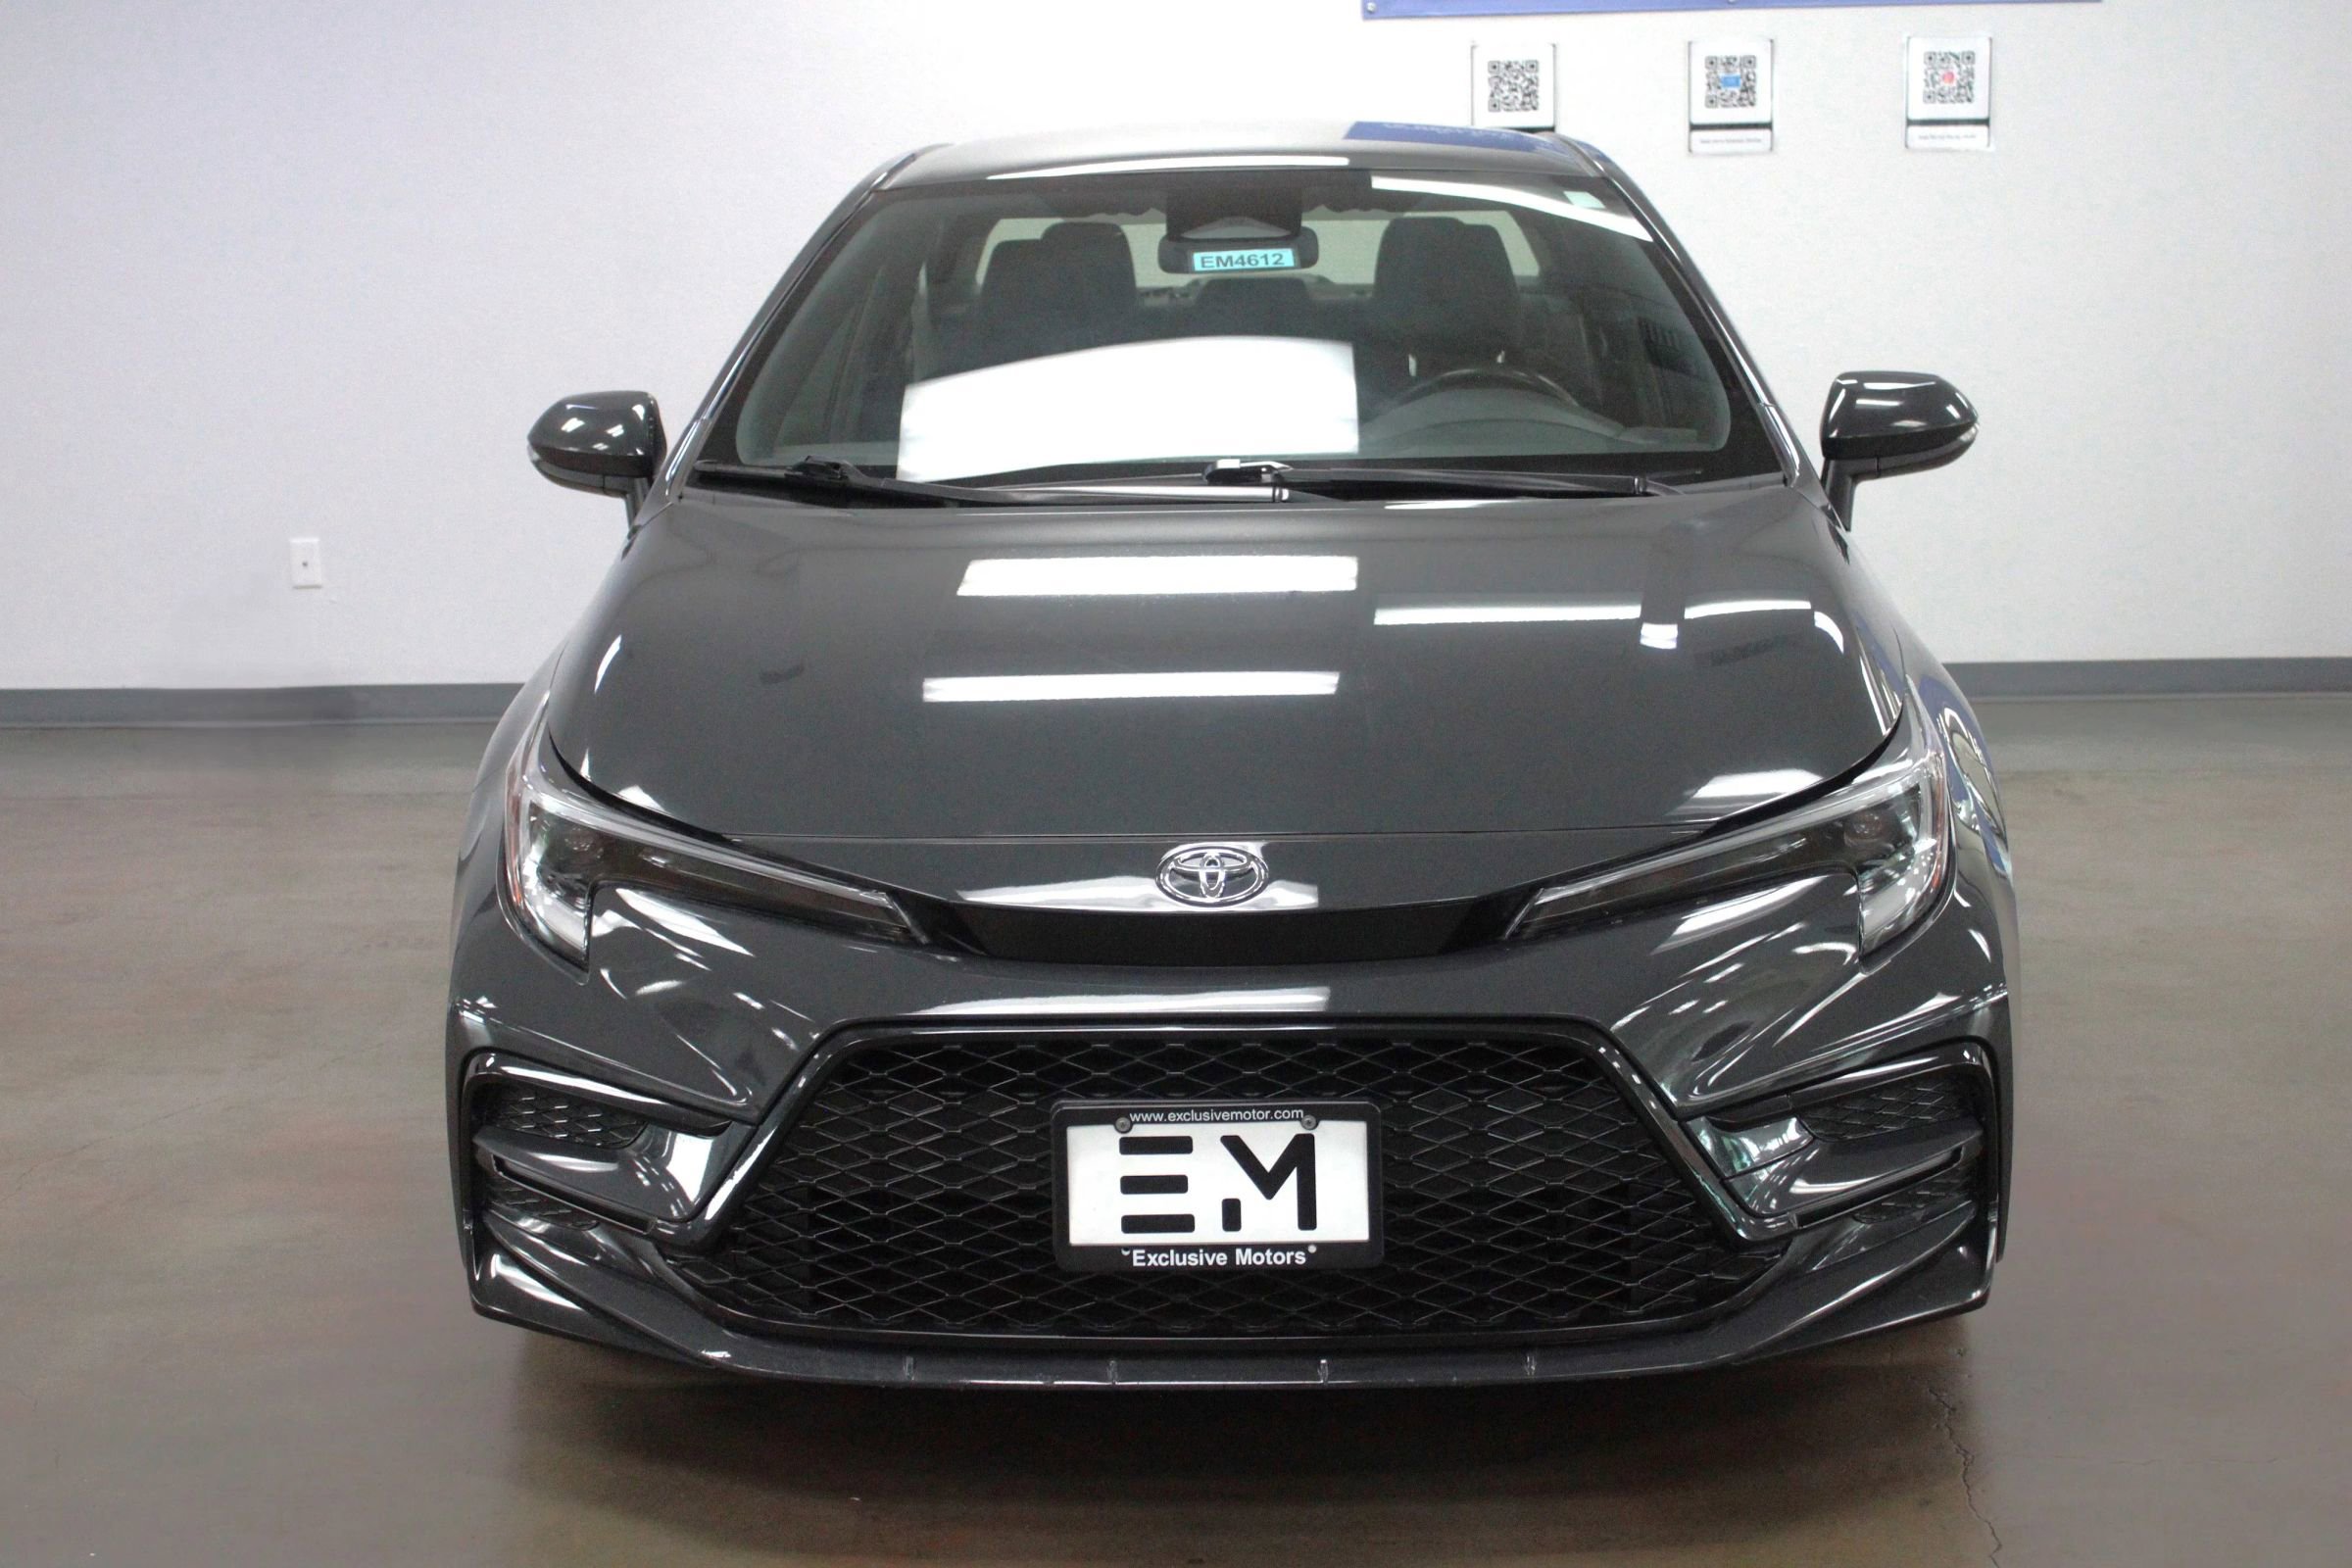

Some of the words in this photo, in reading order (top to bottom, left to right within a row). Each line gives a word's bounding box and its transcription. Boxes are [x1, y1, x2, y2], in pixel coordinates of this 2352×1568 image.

[1200, 253, 1286, 269] EM4612
[1129, 1107, 1304, 1123] www.exclusivemotor.com
[1132, 1248, 1228, 1267] Exclusive
[1235, 1247, 1307, 1266] Motors
